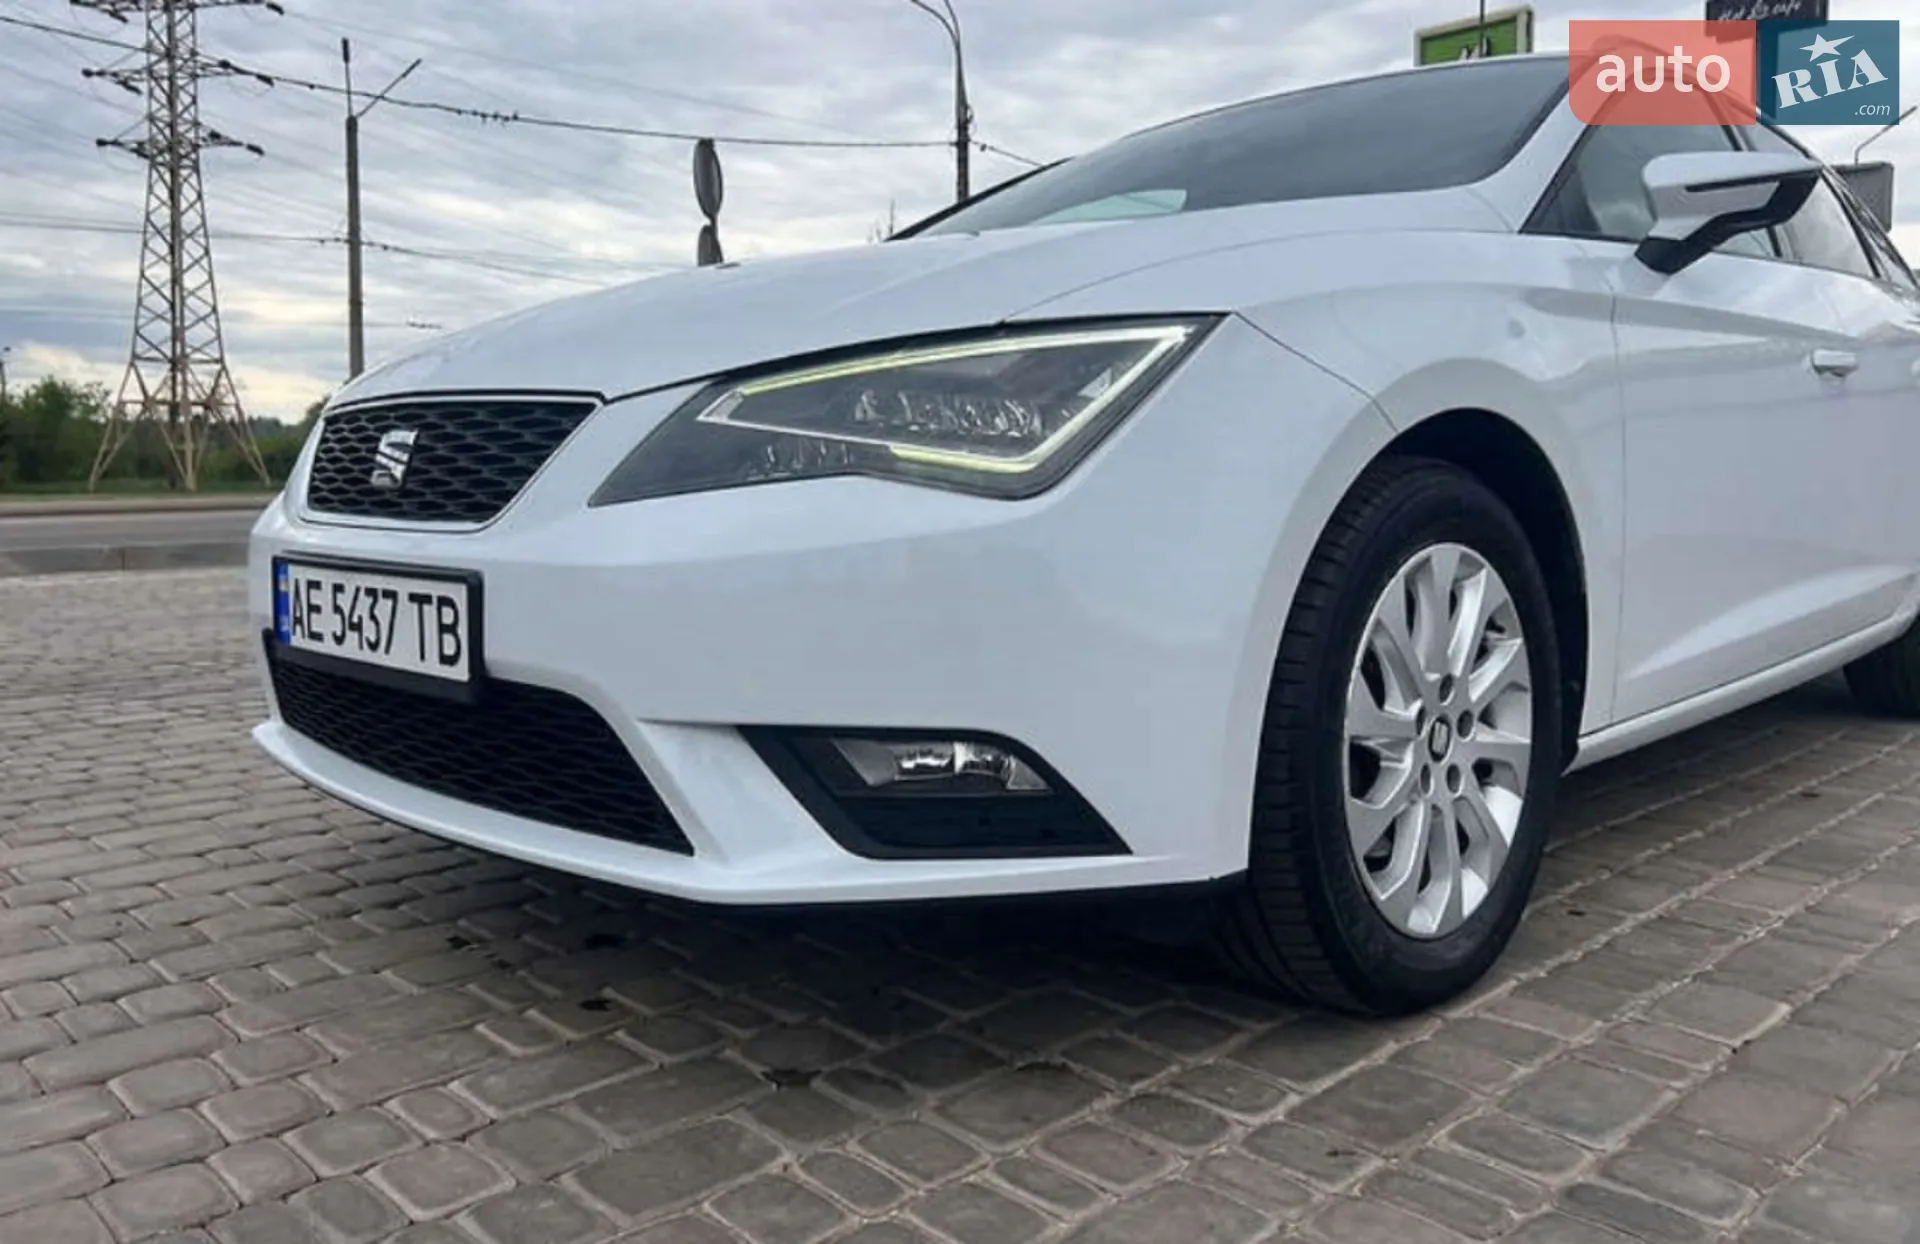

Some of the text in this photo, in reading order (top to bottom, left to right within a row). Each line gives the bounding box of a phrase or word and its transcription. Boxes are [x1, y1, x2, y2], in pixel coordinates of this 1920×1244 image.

[292, 577, 462, 667] AE 5437 TB
